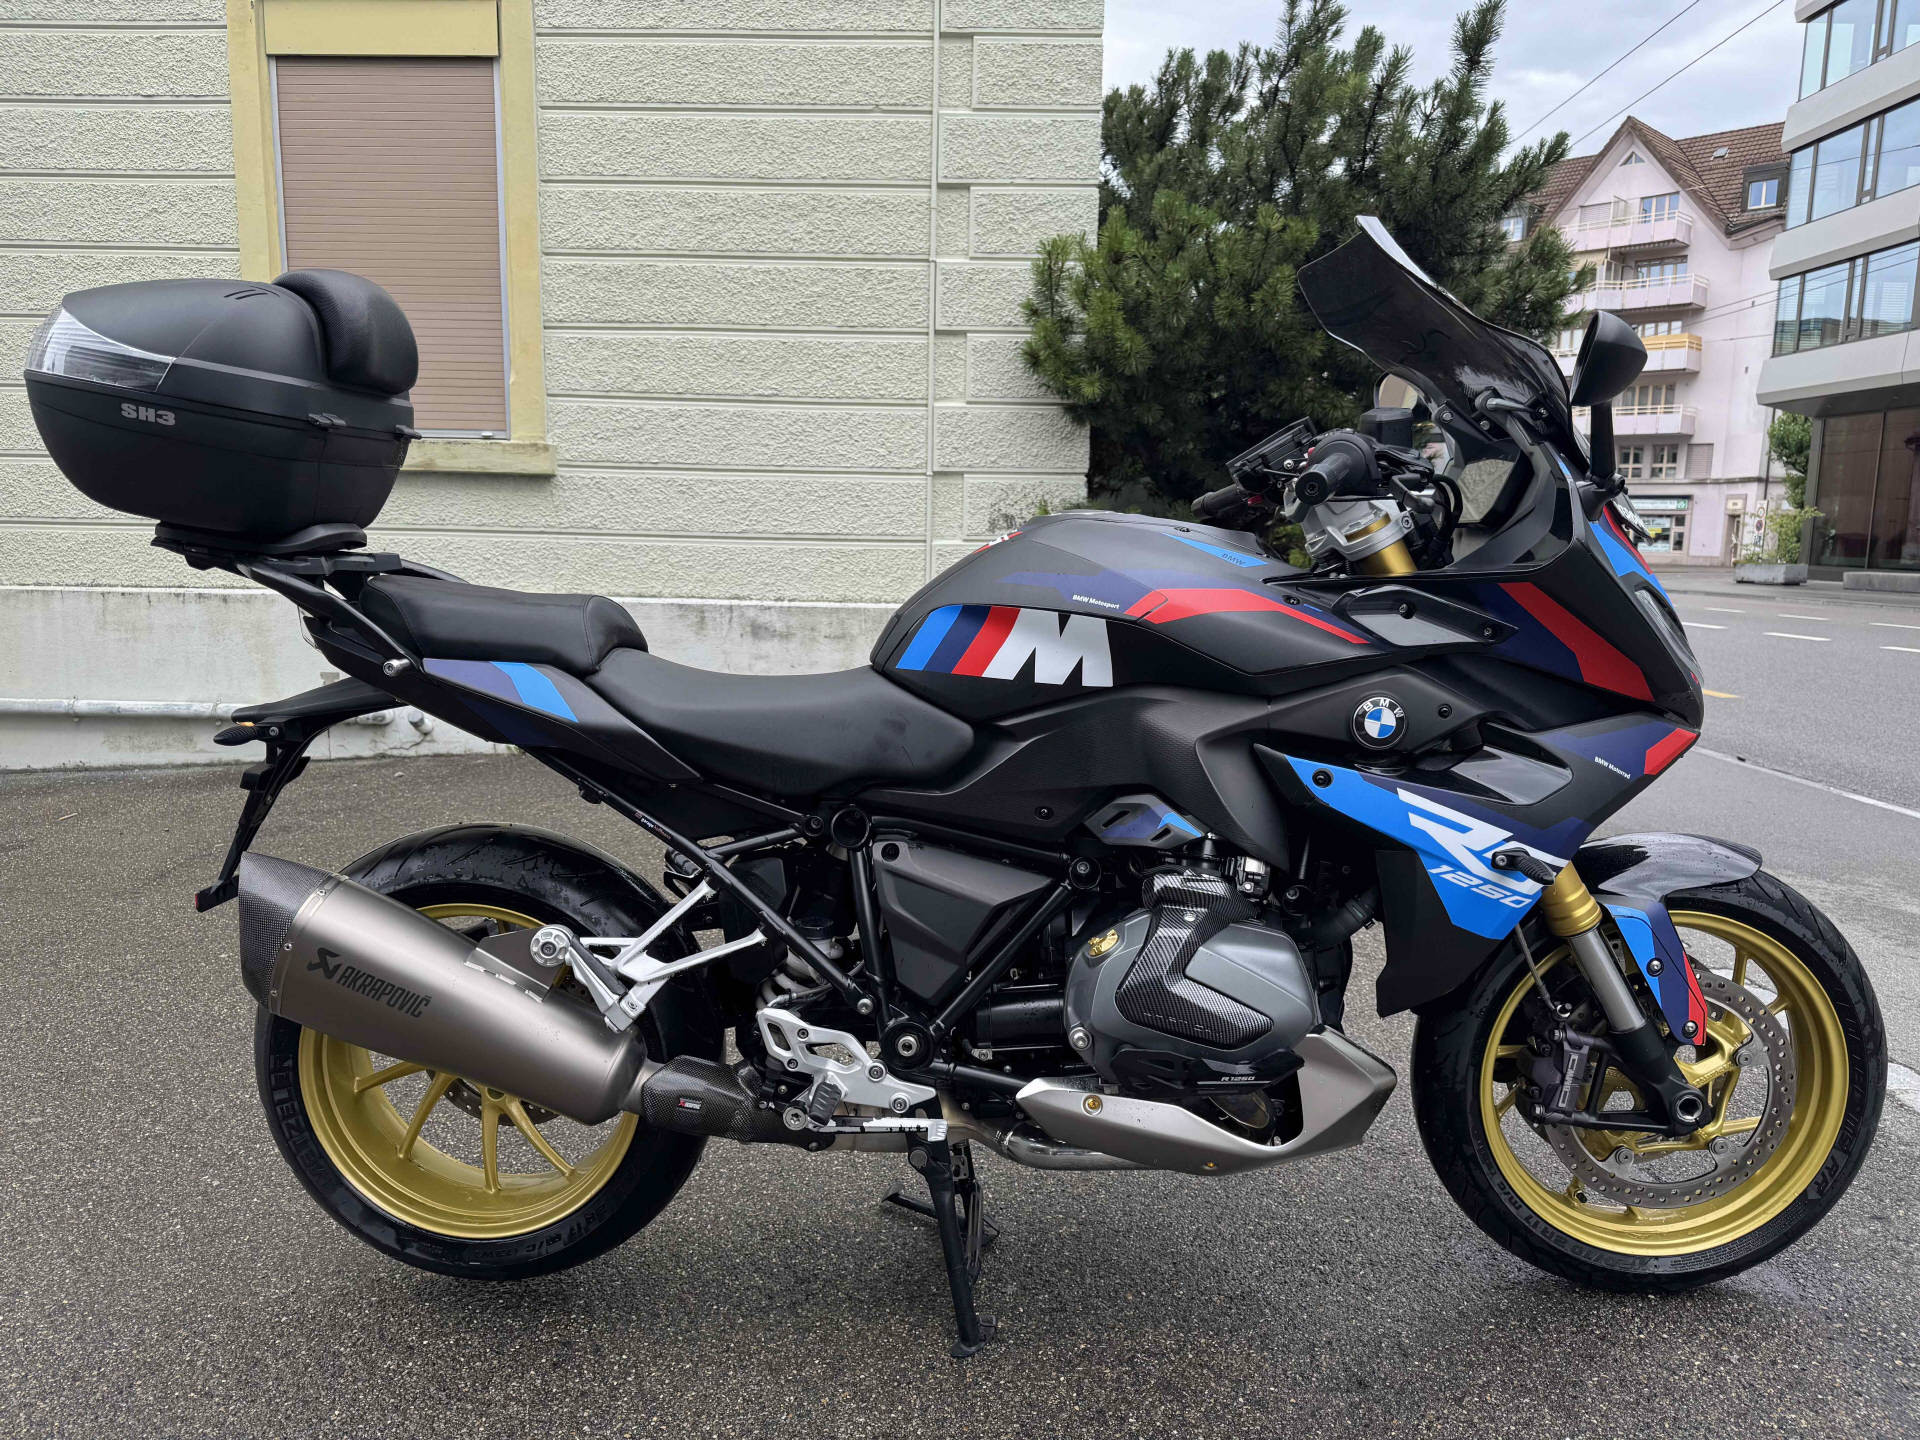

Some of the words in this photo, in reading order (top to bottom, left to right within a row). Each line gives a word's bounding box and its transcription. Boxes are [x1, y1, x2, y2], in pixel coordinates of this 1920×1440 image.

[121, 403, 176, 426] SH3
[1222, 553, 1247, 566] BMW
[1072, 594, 1089, 604] BMW
[981, 608, 1113, 687] M
[1362, 697, 1406, 718] BMW
[1594, 755, 1610, 768] BMW
[1608, 763, 1632, 780] Motorrad
[1428, 865, 1532, 908] 1250
